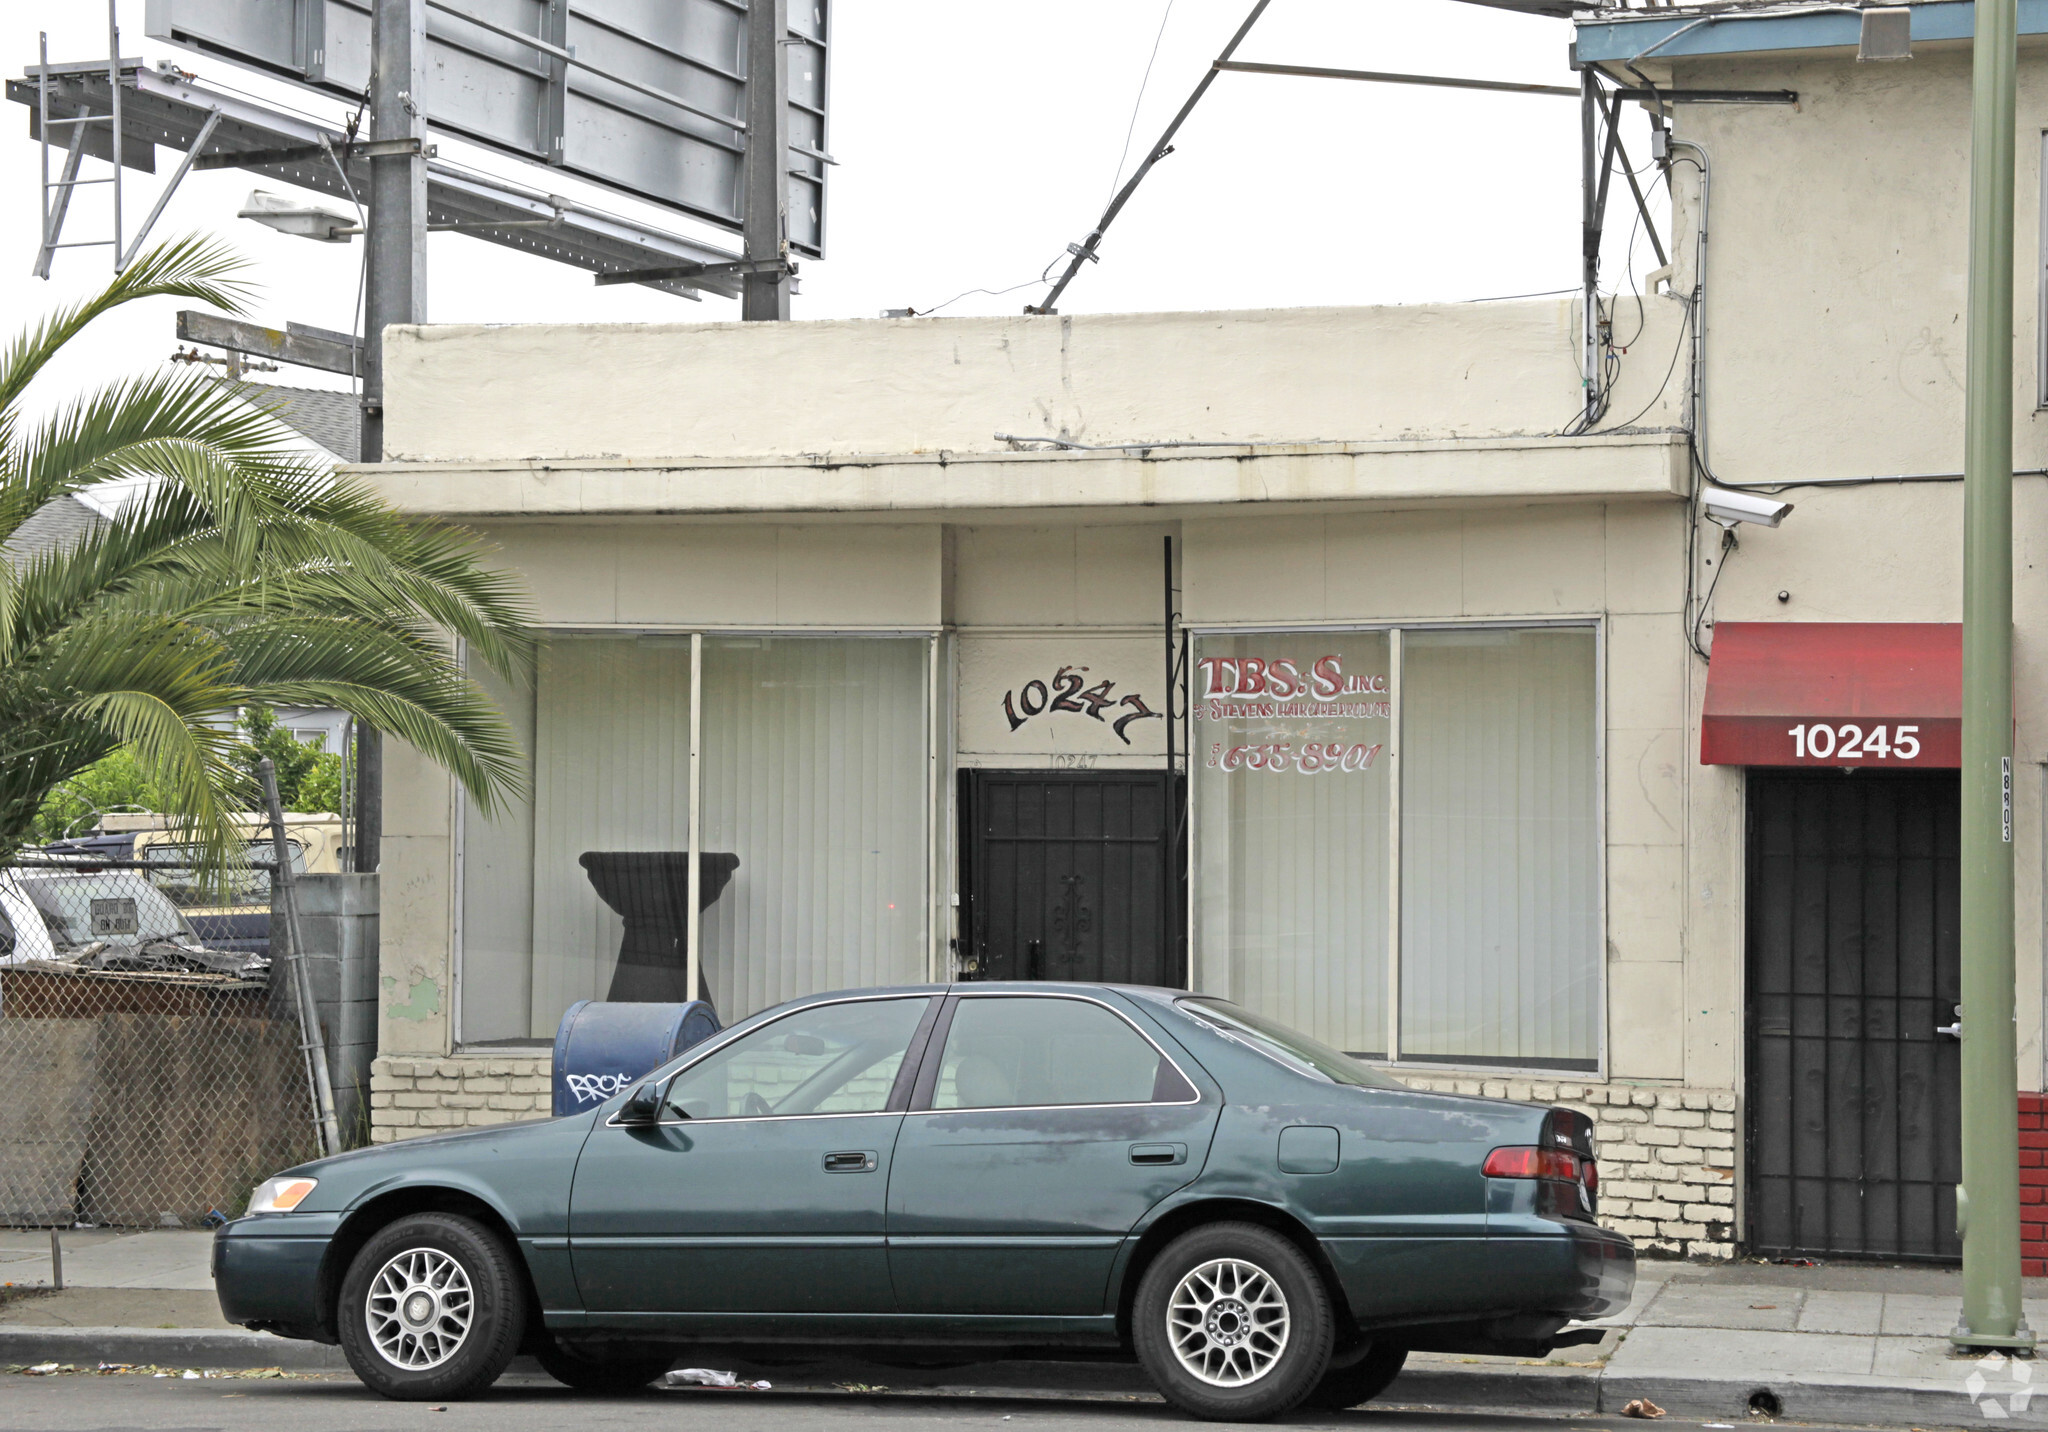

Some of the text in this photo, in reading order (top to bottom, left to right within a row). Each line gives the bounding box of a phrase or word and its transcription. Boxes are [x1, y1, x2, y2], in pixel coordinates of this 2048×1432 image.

[1001, 665, 1164, 746] 10247
[1210, 698, 1275, 722] STEVENS
[1220, 742, 1384, 776] 635-8901
[1788, 723, 1921, 760] 10245
